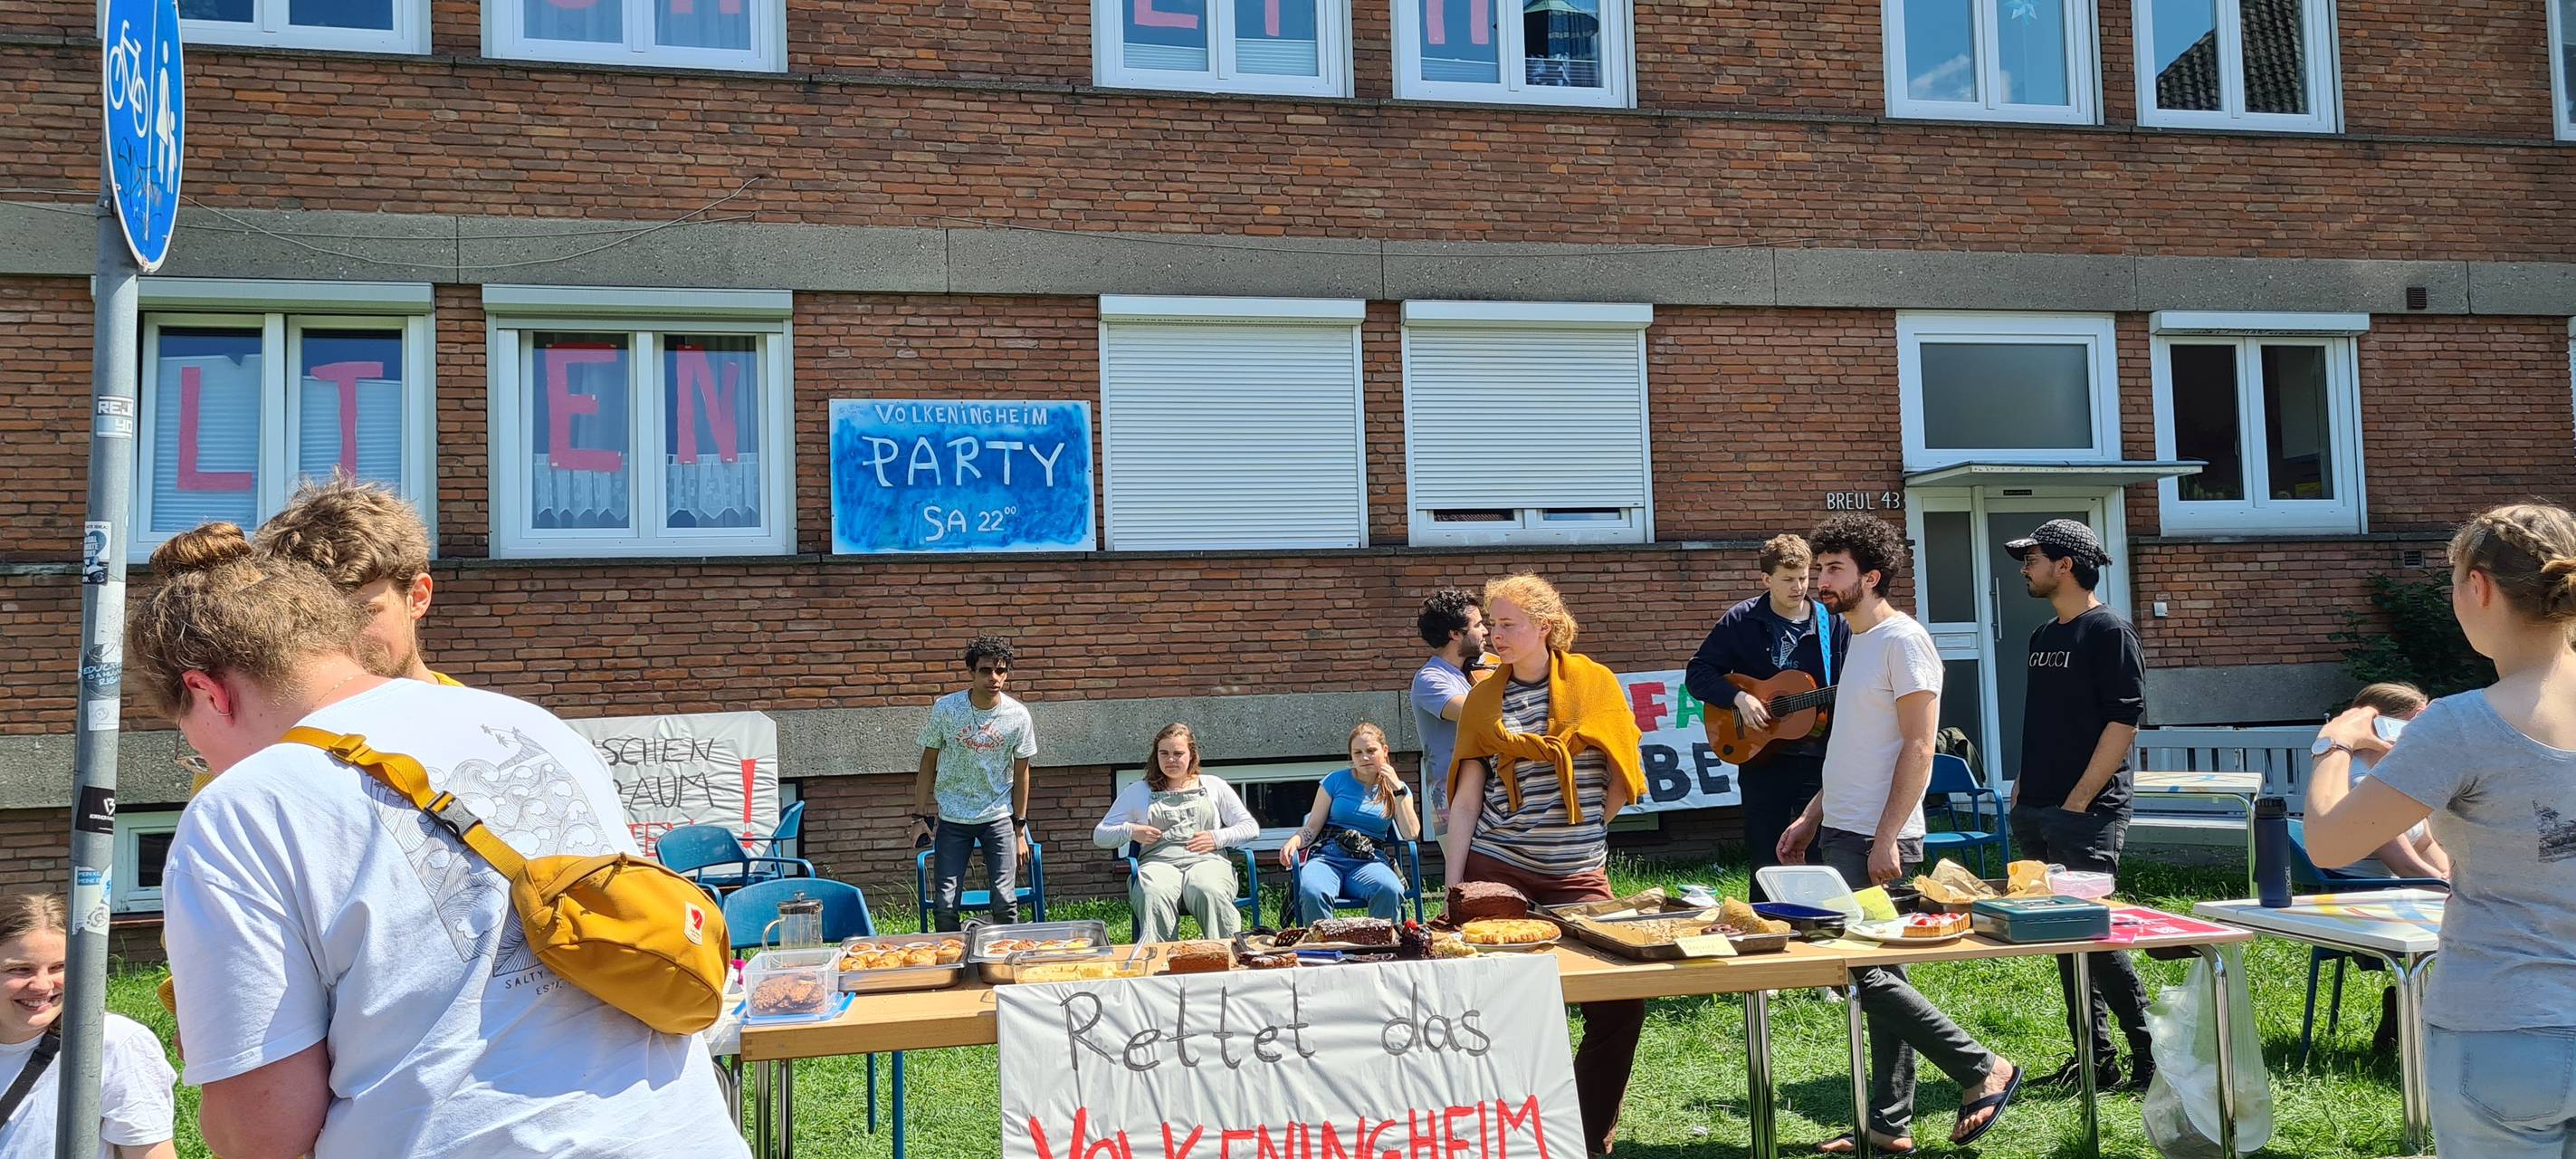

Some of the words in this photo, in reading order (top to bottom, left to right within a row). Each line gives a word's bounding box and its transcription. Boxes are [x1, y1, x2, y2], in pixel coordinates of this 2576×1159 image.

[862, 436, 1065, 487] PARTY
[1827, 492, 1876, 510] BREUL
[1881, 492, 1901, 509] 43
[923, 505, 967, 541] SA
[2029, 651, 2071, 667] GUCCI
[593, 737, 714, 766] SCHEN
[505, 970, 545, 990] SALTY
[1059, 981, 1317, 1072] Rettet
[1380, 982, 1492, 1058] das
